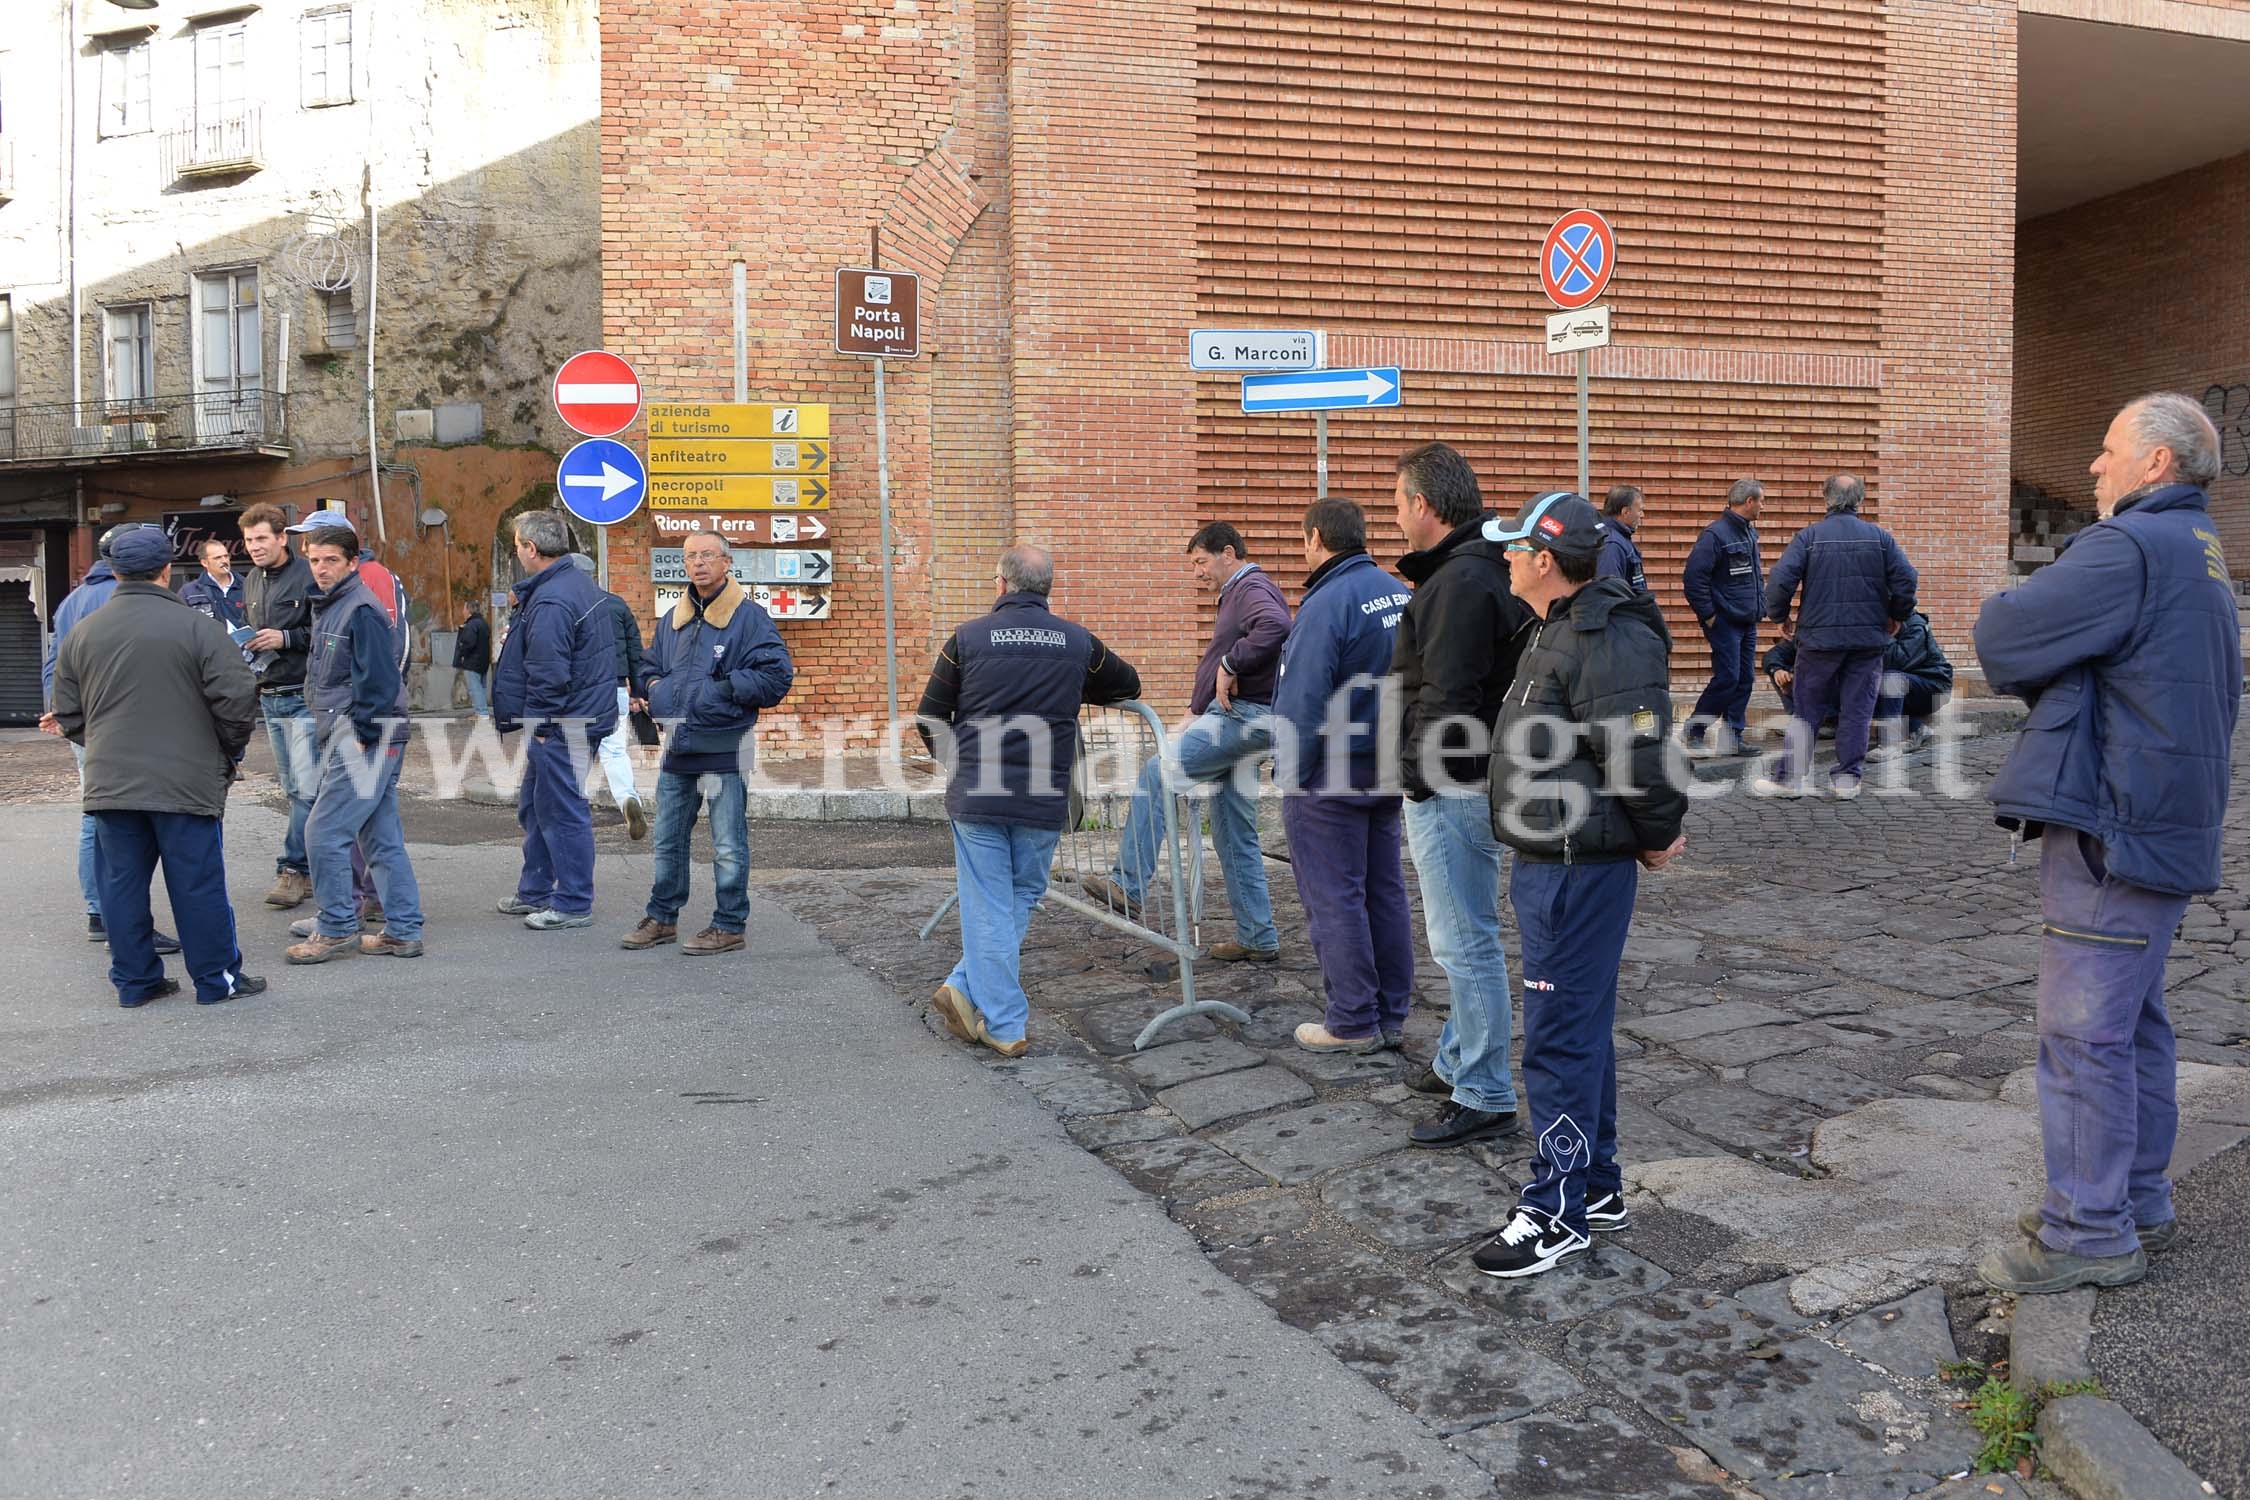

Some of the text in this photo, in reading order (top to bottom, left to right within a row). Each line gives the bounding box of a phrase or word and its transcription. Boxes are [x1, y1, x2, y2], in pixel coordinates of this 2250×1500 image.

[855, 306, 901, 323] Porta
[850, 323, 905, 342] Napoli
[1292, 336, 1306, 344] via
[1208, 346, 1307, 360] G. Marconi
[651, 405, 710, 417] azienda
[650, 422, 730, 433] di turismo
[651, 450, 727, 462] anfiteatro
[651, 479, 724, 496] necropoli
[651, 495, 709, 505] romana
[654, 515, 756, 531] Rione Terra
[1361, 595, 1393, 615] CASSA
